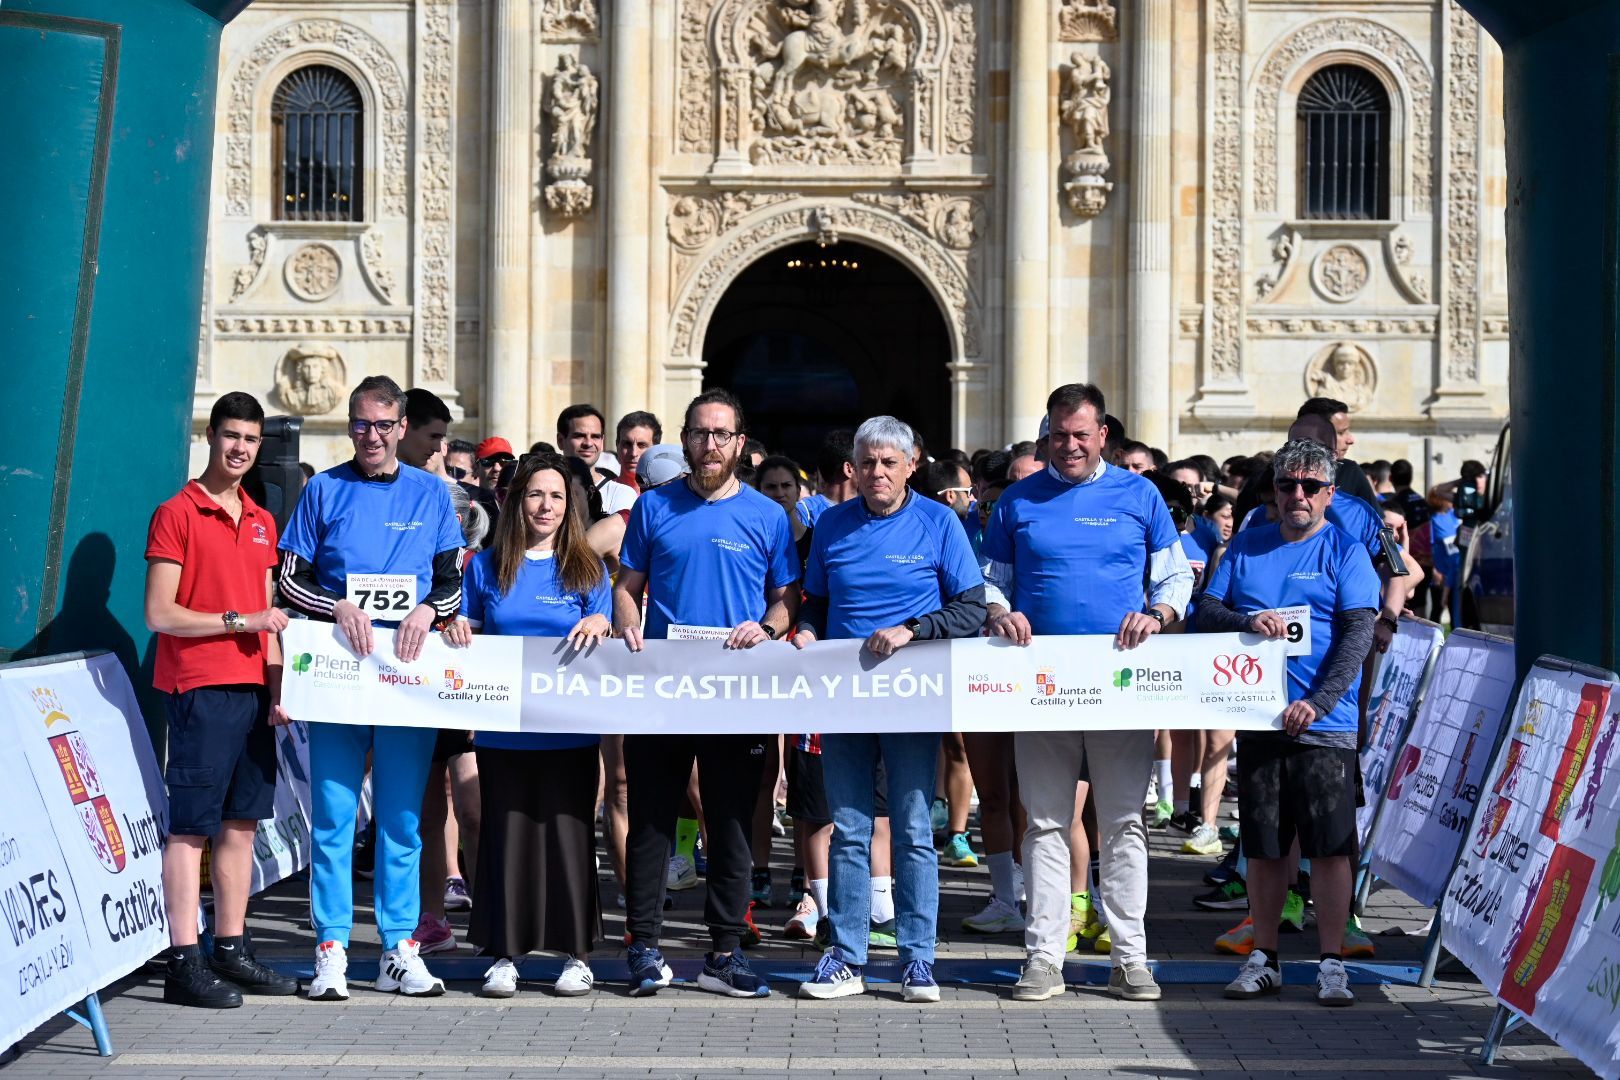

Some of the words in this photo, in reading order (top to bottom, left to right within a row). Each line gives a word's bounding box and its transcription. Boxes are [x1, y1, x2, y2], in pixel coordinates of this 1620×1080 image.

[354, 590, 410, 610] 752
[1287, 622, 1304, 643] 9
[315, 654, 361, 672] Plena
[378, 664, 398, 673] NOS
[314, 668, 360, 681] inclusión
[378, 673, 430, 686] IMPULSA
[968, 673, 989, 682] NOS
[1136, 668, 1182, 682] Plena
[465, 682, 494, 691] Junta
[496, 684, 510, 692] de
[530, 666, 591, 697] DÍA
[600, 674, 644, 698] DE
[655, 675, 814, 700] CASTILLA
[820, 675, 842, 698] Y
[852, 667, 943, 698] LEÓN
[968, 682, 1022, 695] IMPULSA
[1136, 682, 1182, 692] inclusión
[438, 691, 473, 700] Castilla
[475, 694, 481, 702] y
[484, 692, 509, 701] León
[1058, 687, 1086, 695] Junta
[1089, 687, 1102, 695] de
[1030, 697, 1066, 705] Castilla
[1068, 699, 1074, 707] y
[1077, 697, 1102, 705] León
